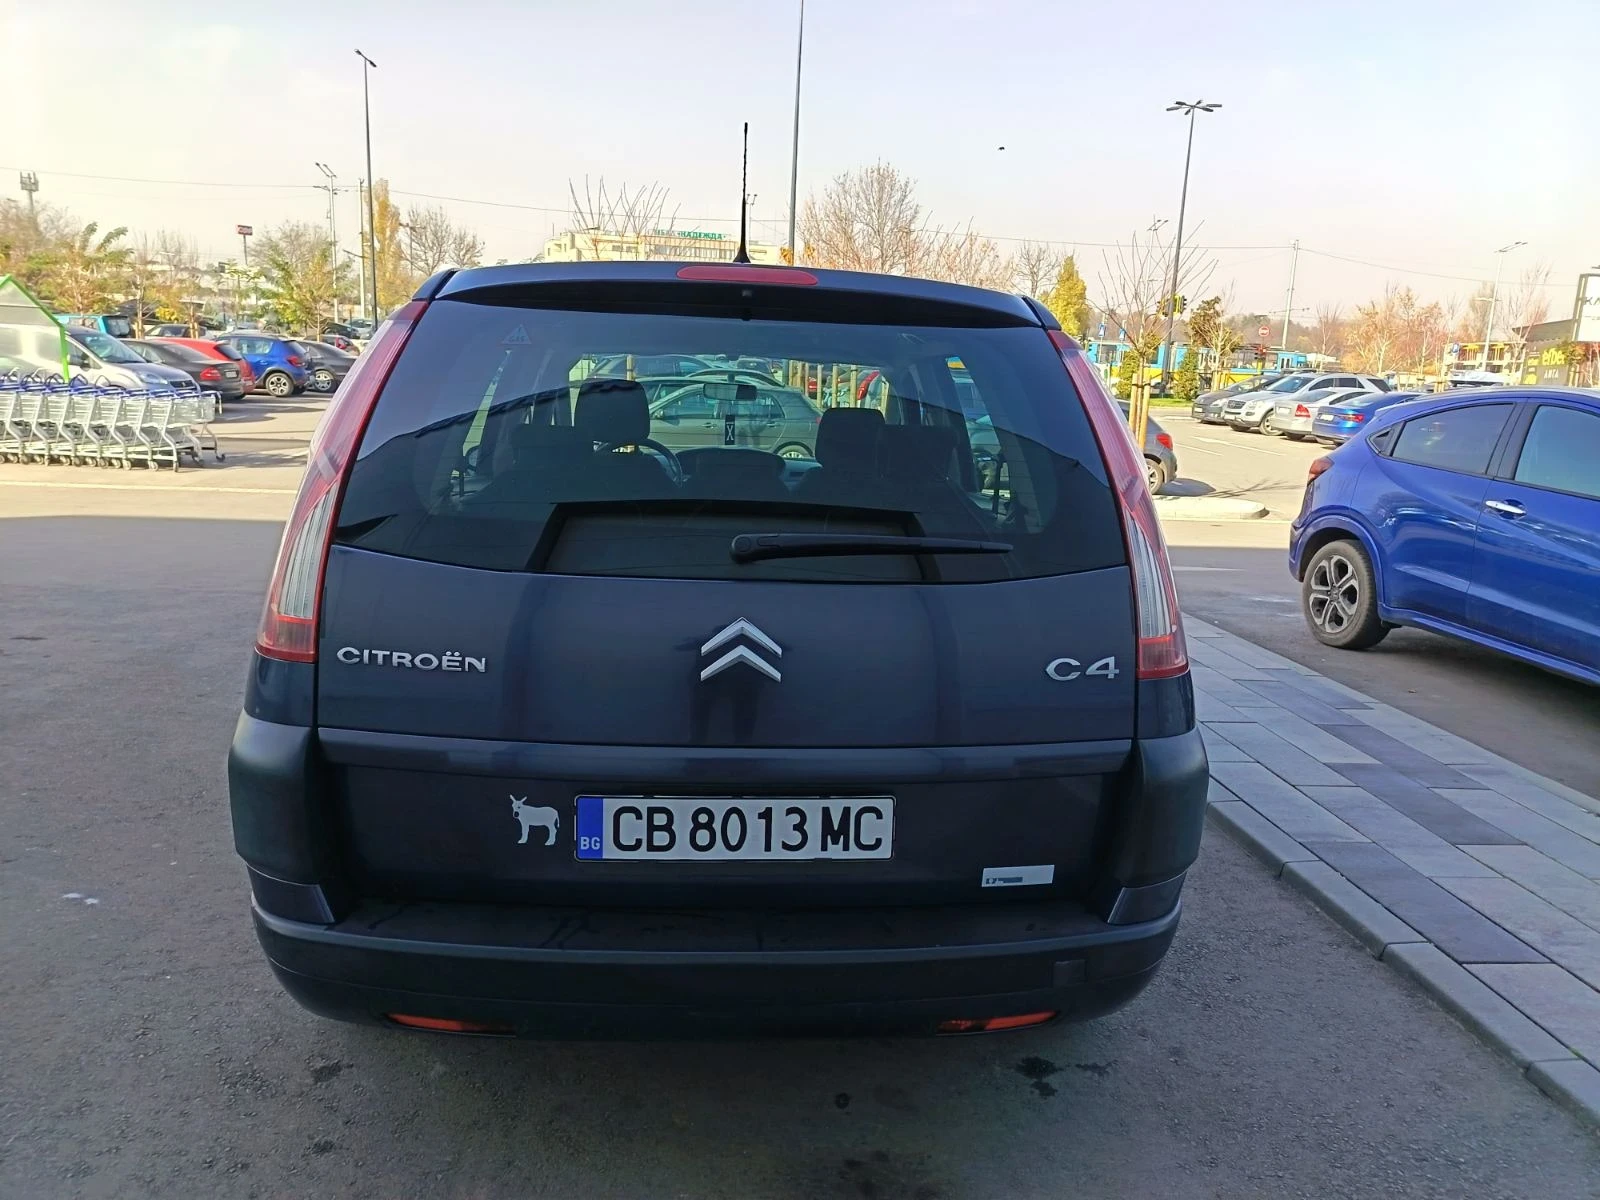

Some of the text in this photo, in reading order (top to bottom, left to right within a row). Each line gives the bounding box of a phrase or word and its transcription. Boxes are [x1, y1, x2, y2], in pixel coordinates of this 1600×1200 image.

[336, 646, 486, 673] CITROËN
[1045, 656, 1120, 681] C4
[612, 805, 884, 853] CB 8013 MC
[580, 836, 600, 850] BG
